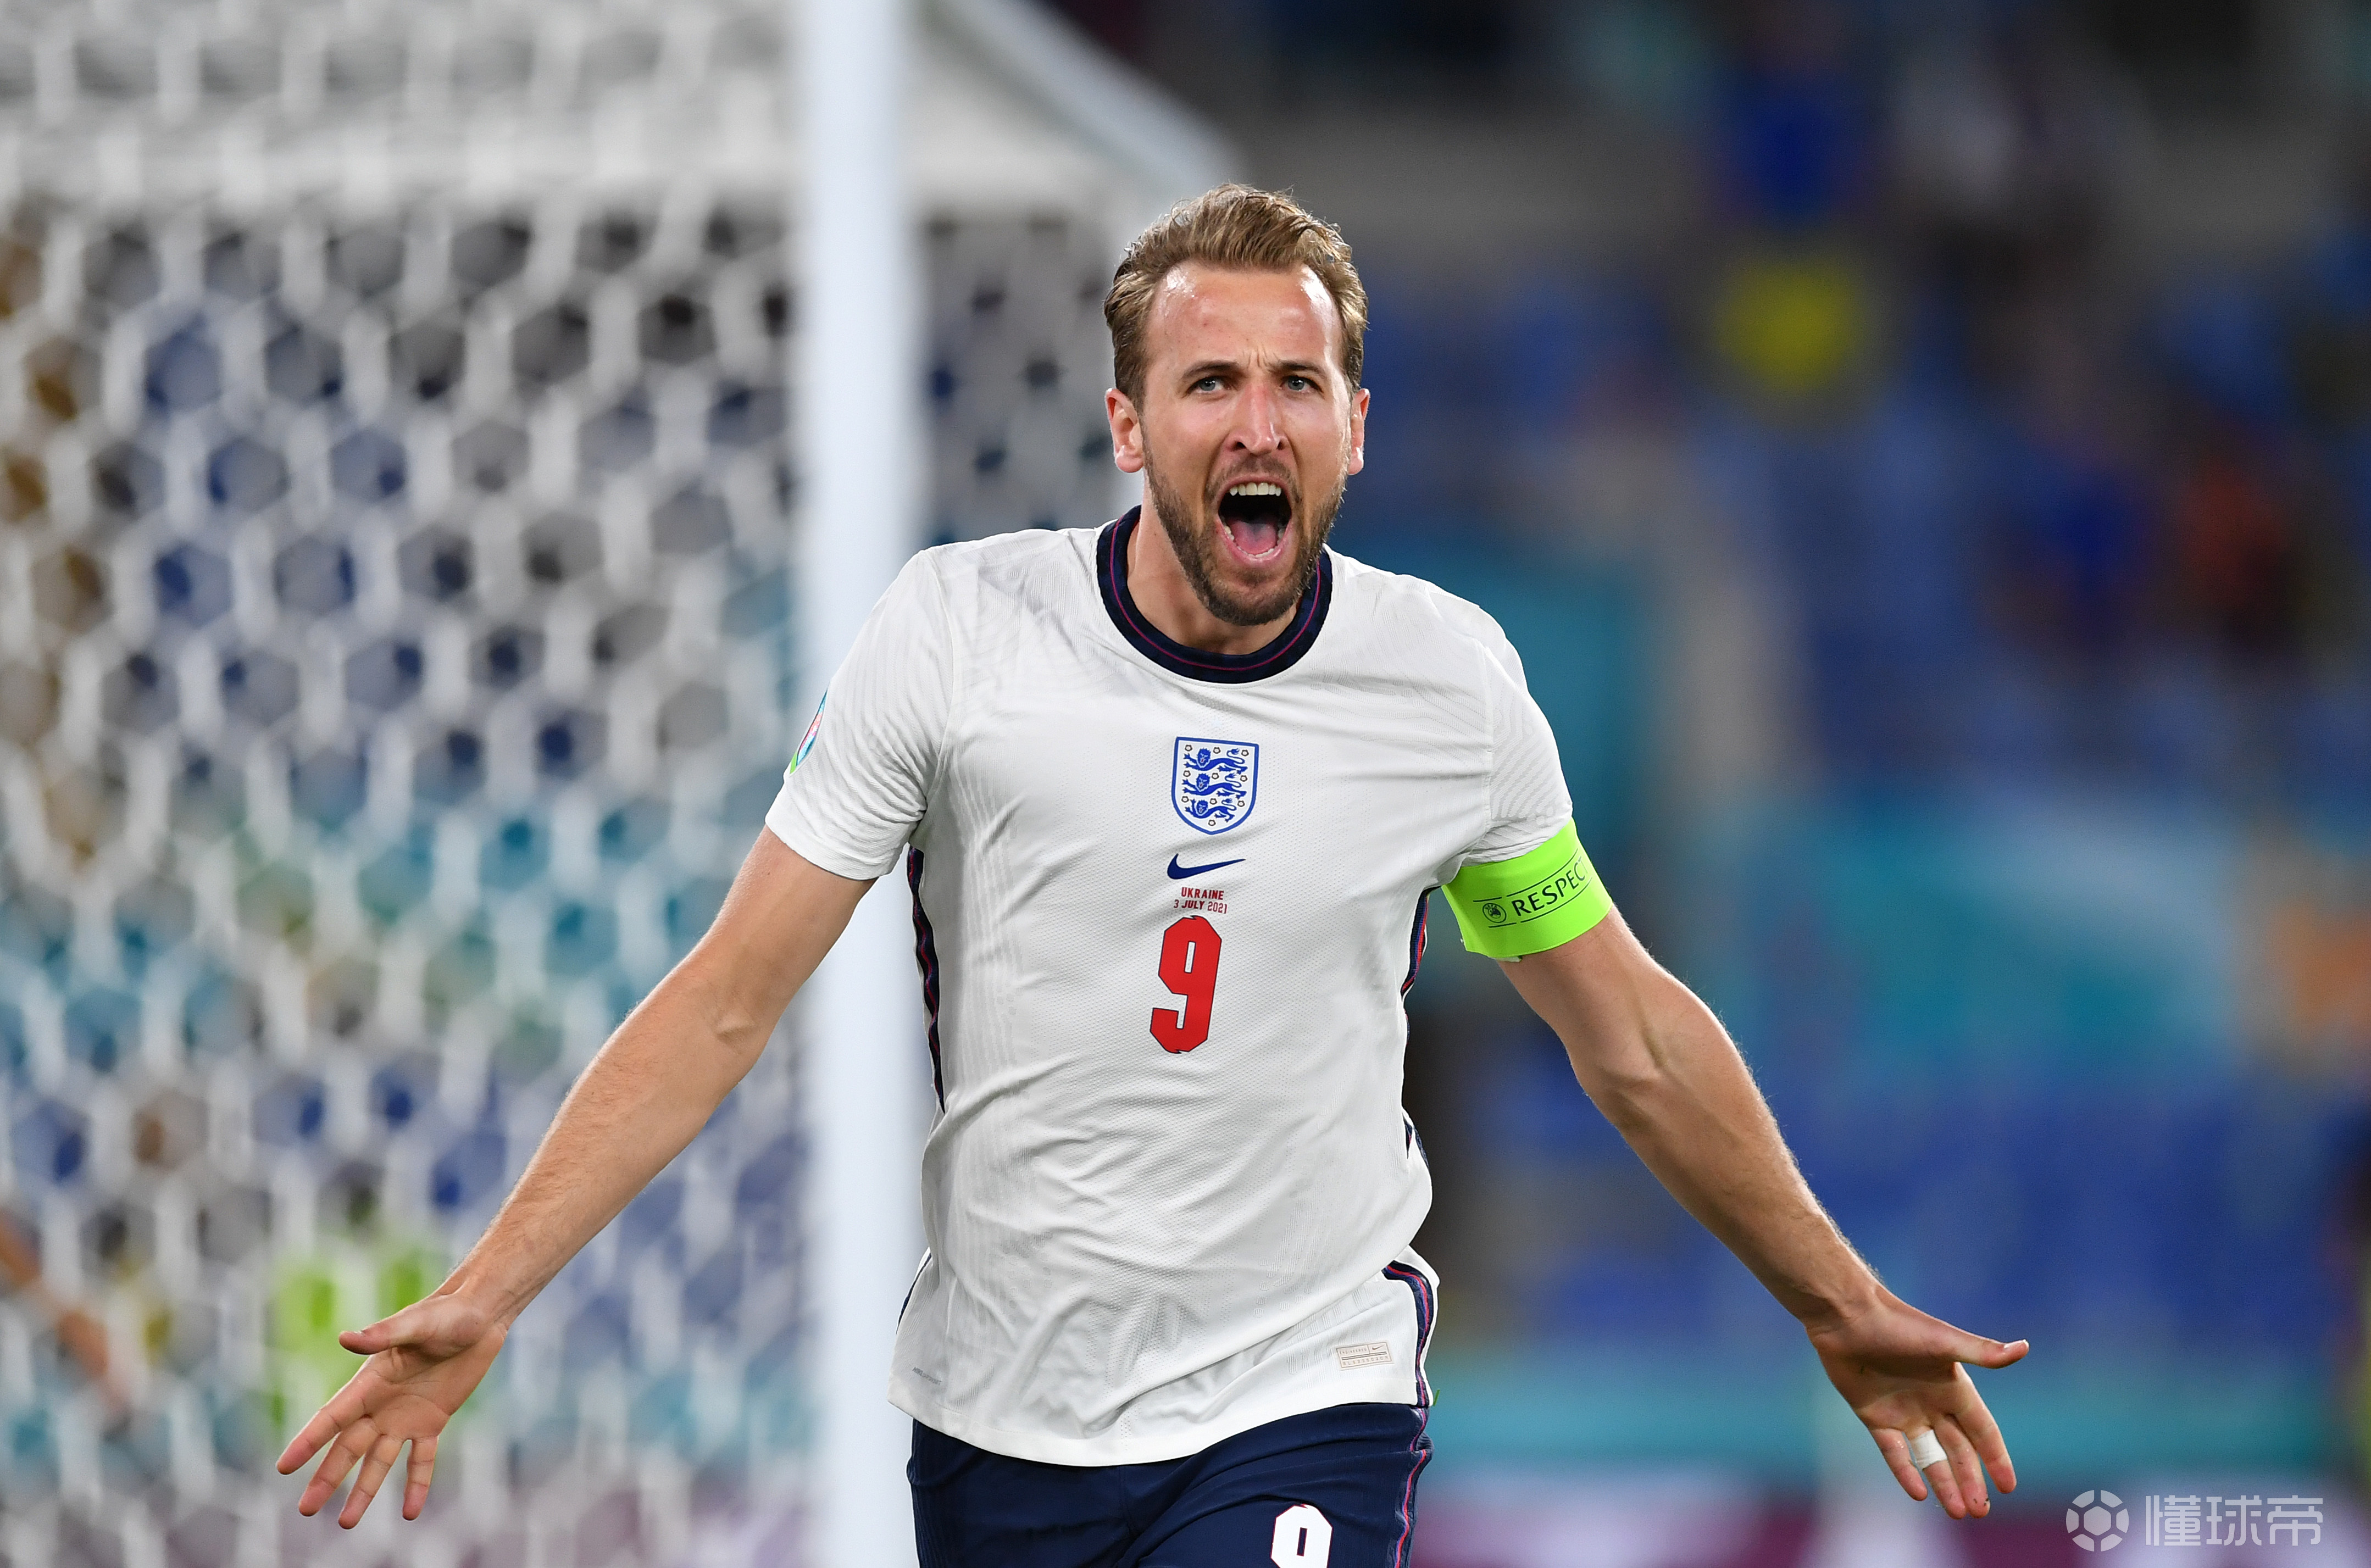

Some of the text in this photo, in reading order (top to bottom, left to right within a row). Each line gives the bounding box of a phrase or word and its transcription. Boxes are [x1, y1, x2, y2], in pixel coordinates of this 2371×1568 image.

[1181, 886, 1224, 900] UKRAINE
[1511, 856, 1588, 916] RESPECT
[1173, 899, 1228, 914] 3 JULY 2021
[1150, 915, 1222, 1054] 9
